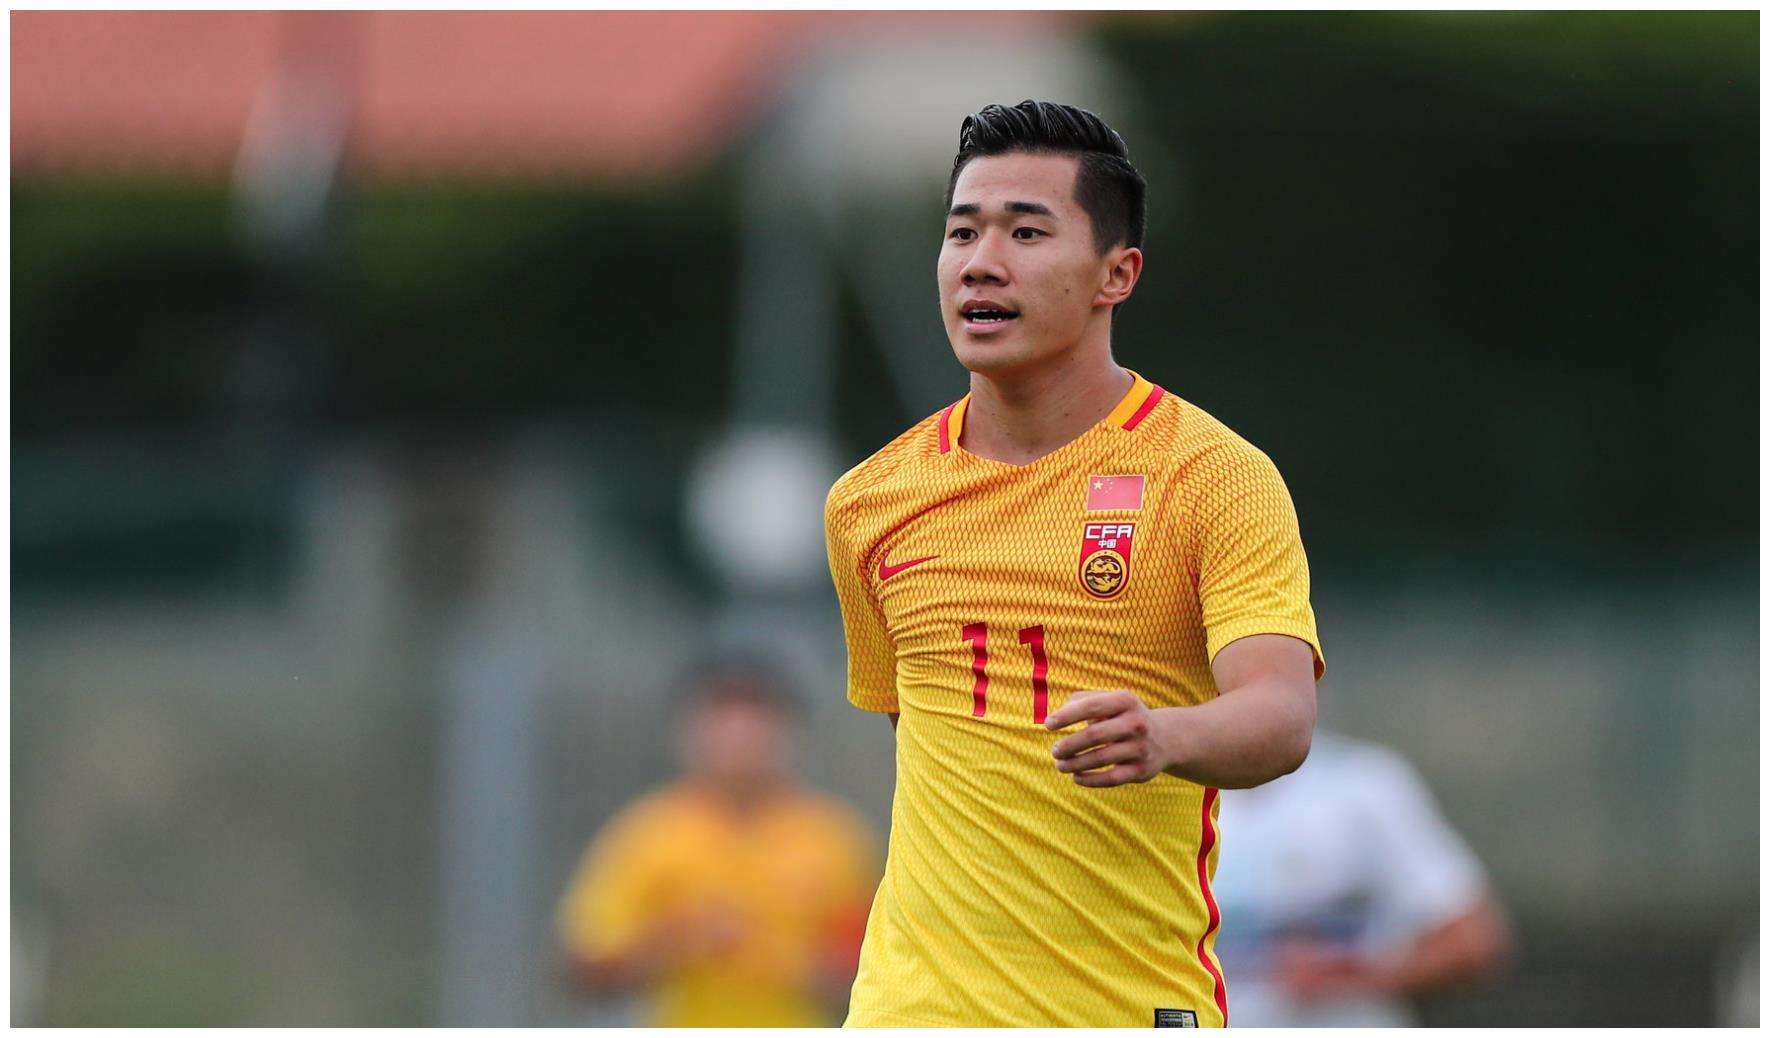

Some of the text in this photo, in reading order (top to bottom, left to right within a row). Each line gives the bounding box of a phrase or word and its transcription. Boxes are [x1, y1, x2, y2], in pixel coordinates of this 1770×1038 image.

[1086, 525, 1132, 539] CFA
[1098, 539, 1116, 548] 中国
[962, 622, 1048, 724] 11
